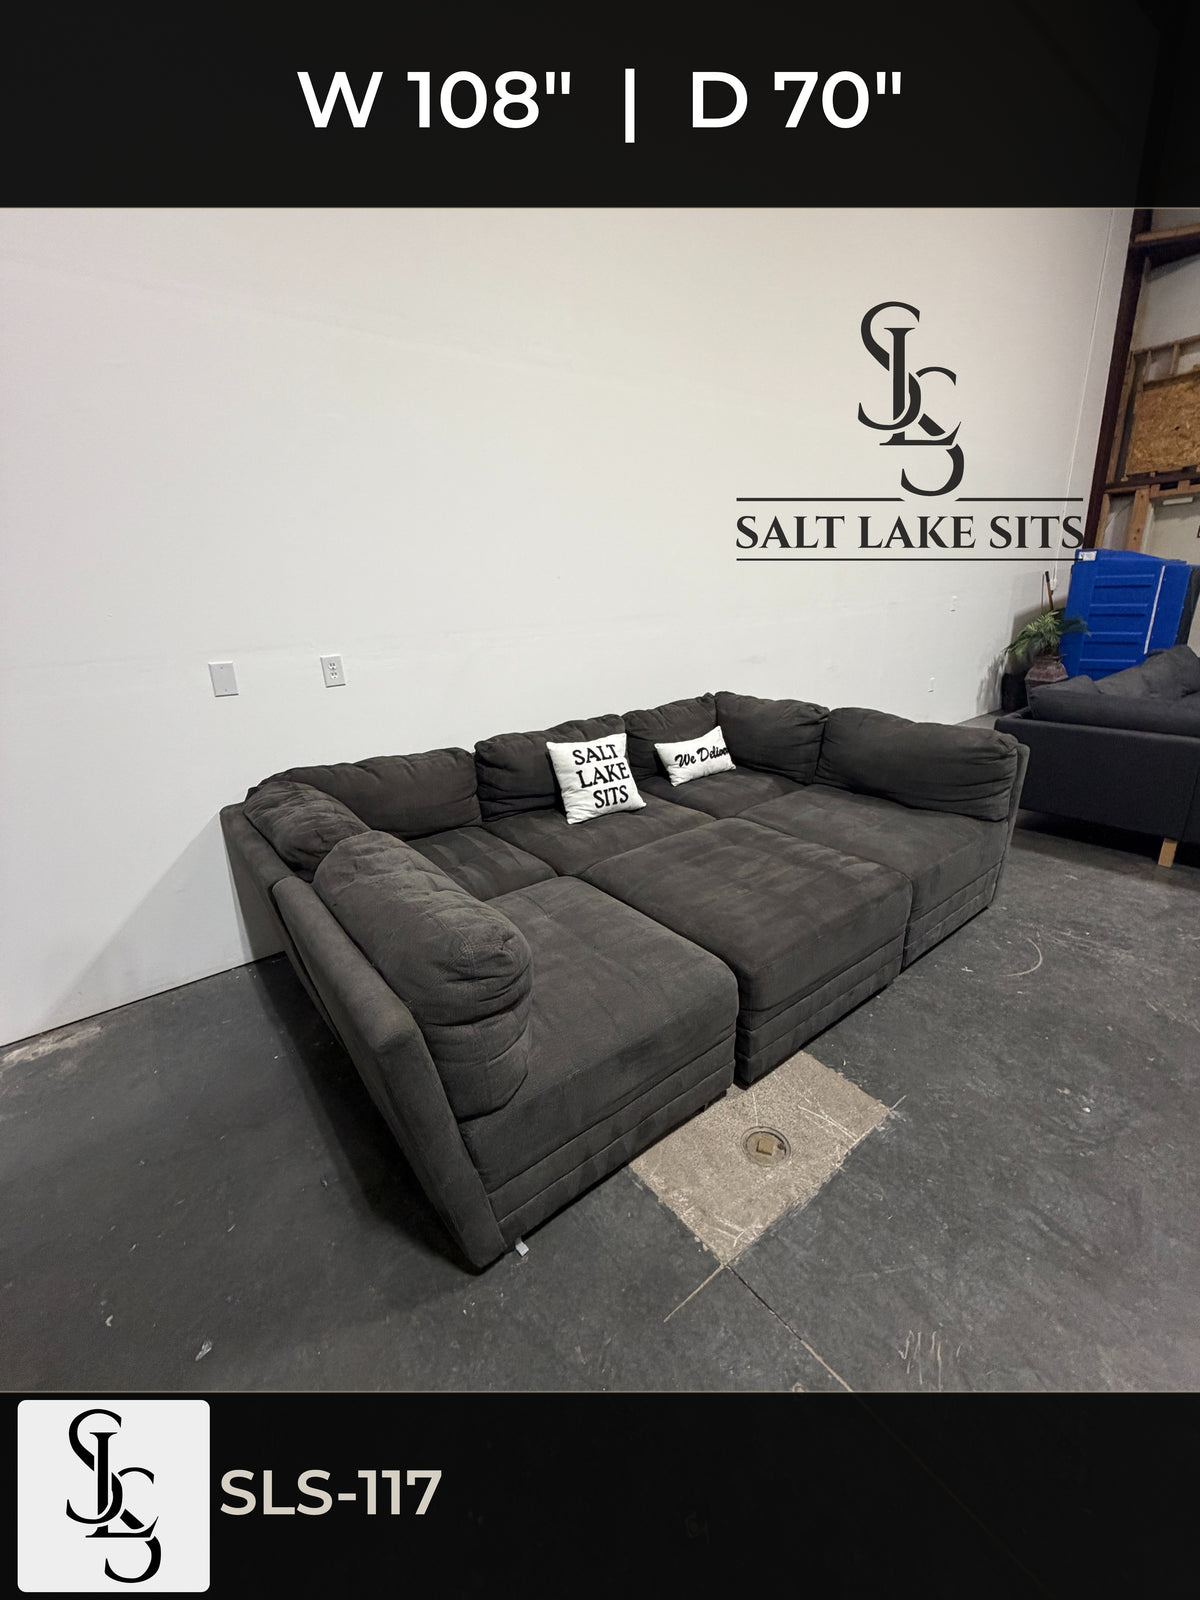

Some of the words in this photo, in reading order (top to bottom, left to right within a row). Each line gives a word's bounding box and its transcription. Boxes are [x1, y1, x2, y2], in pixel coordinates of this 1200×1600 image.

[573, 745, 618, 765] SALT
[675, 754, 696, 767] We
[696, 745, 728, 762] Delive
[576, 763, 629, 788] LAKE
[593, 785, 628, 808] SITS
